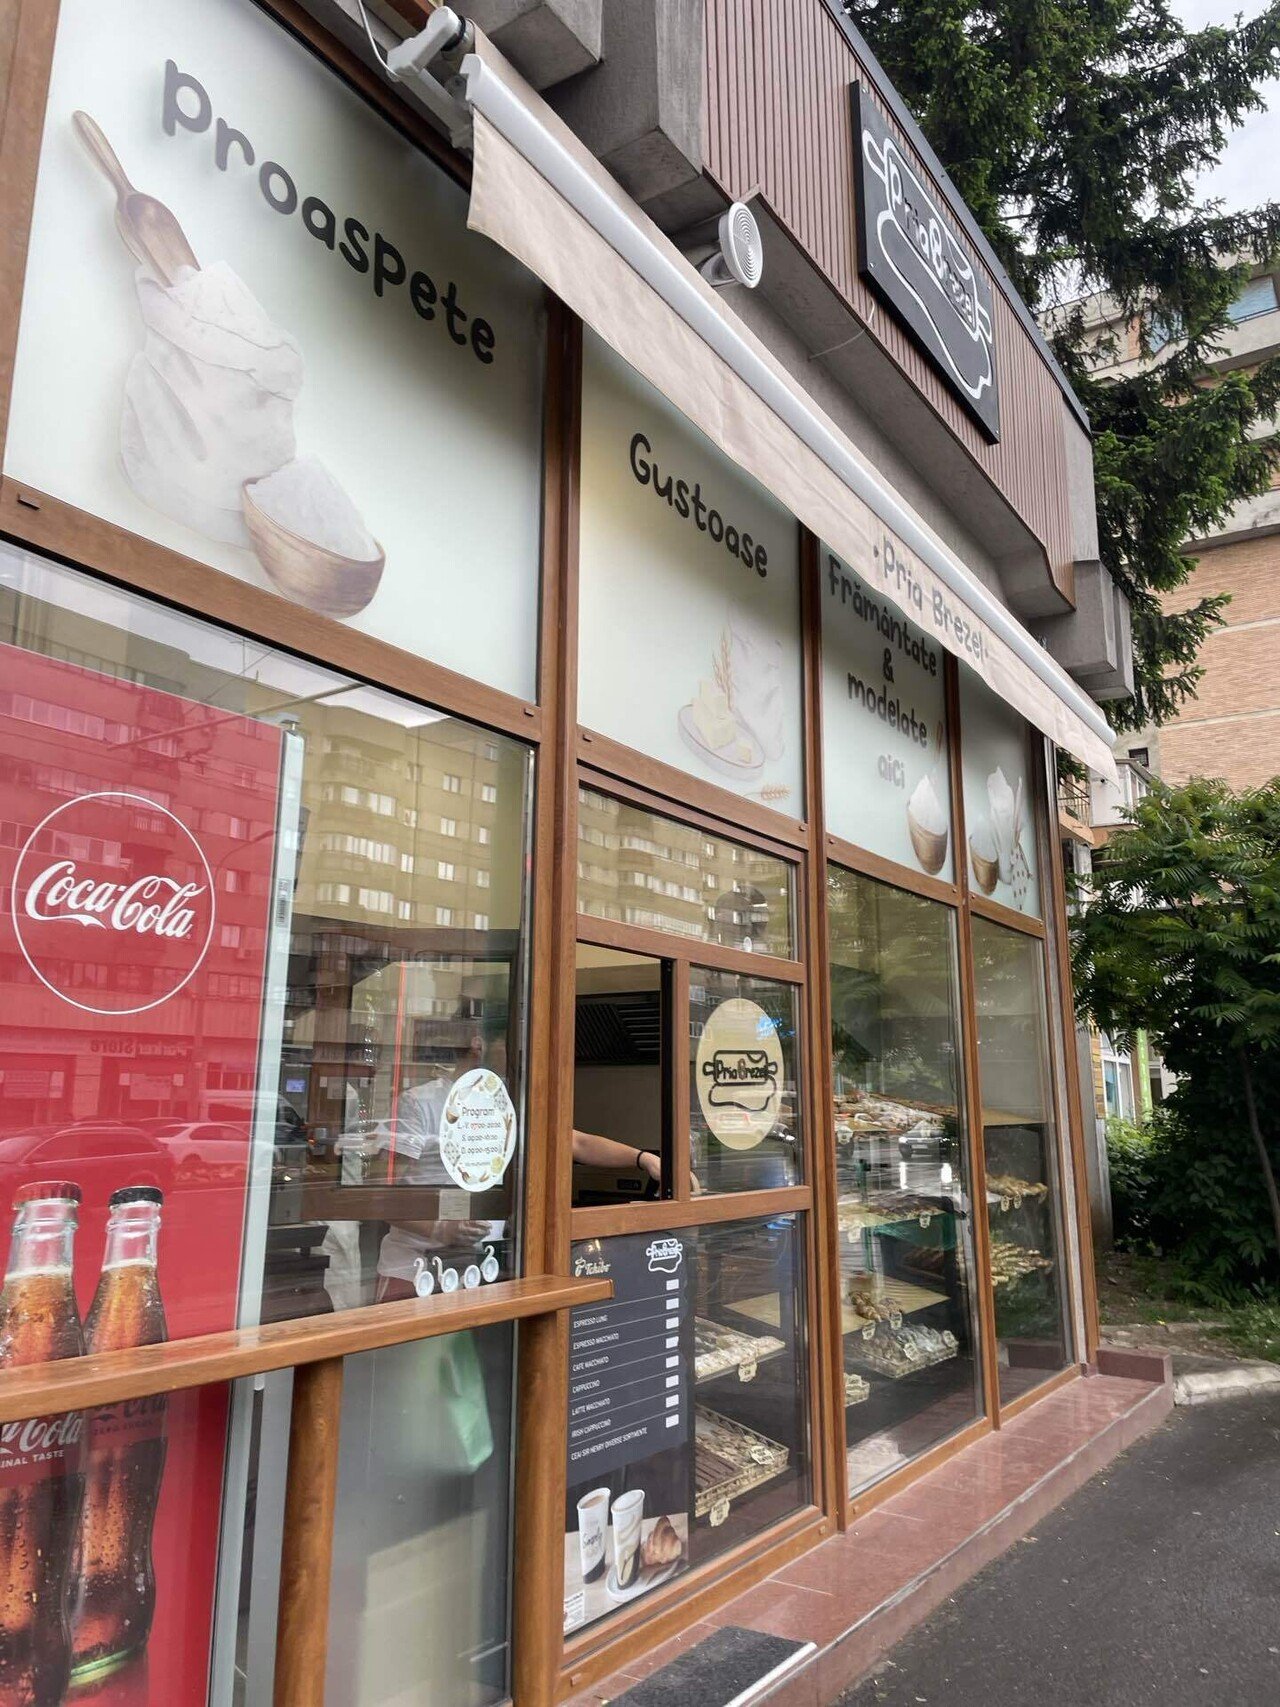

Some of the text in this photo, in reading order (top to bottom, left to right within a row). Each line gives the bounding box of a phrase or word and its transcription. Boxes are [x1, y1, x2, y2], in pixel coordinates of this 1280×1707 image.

[630, 433, 768, 578] Gustoase
[828, 554, 938, 677] Frământate
[883, 536, 984, 660] Pria Brezel
[883, 648, 895, 684] &
[847, 672, 928, 748] modelate
[878, 754, 905, 789] aici
[25, 860, 206, 939] Coca-Cola
[462, 1106, 495, 1119] Program
[33, 1450, 65, 1463] TASTE
